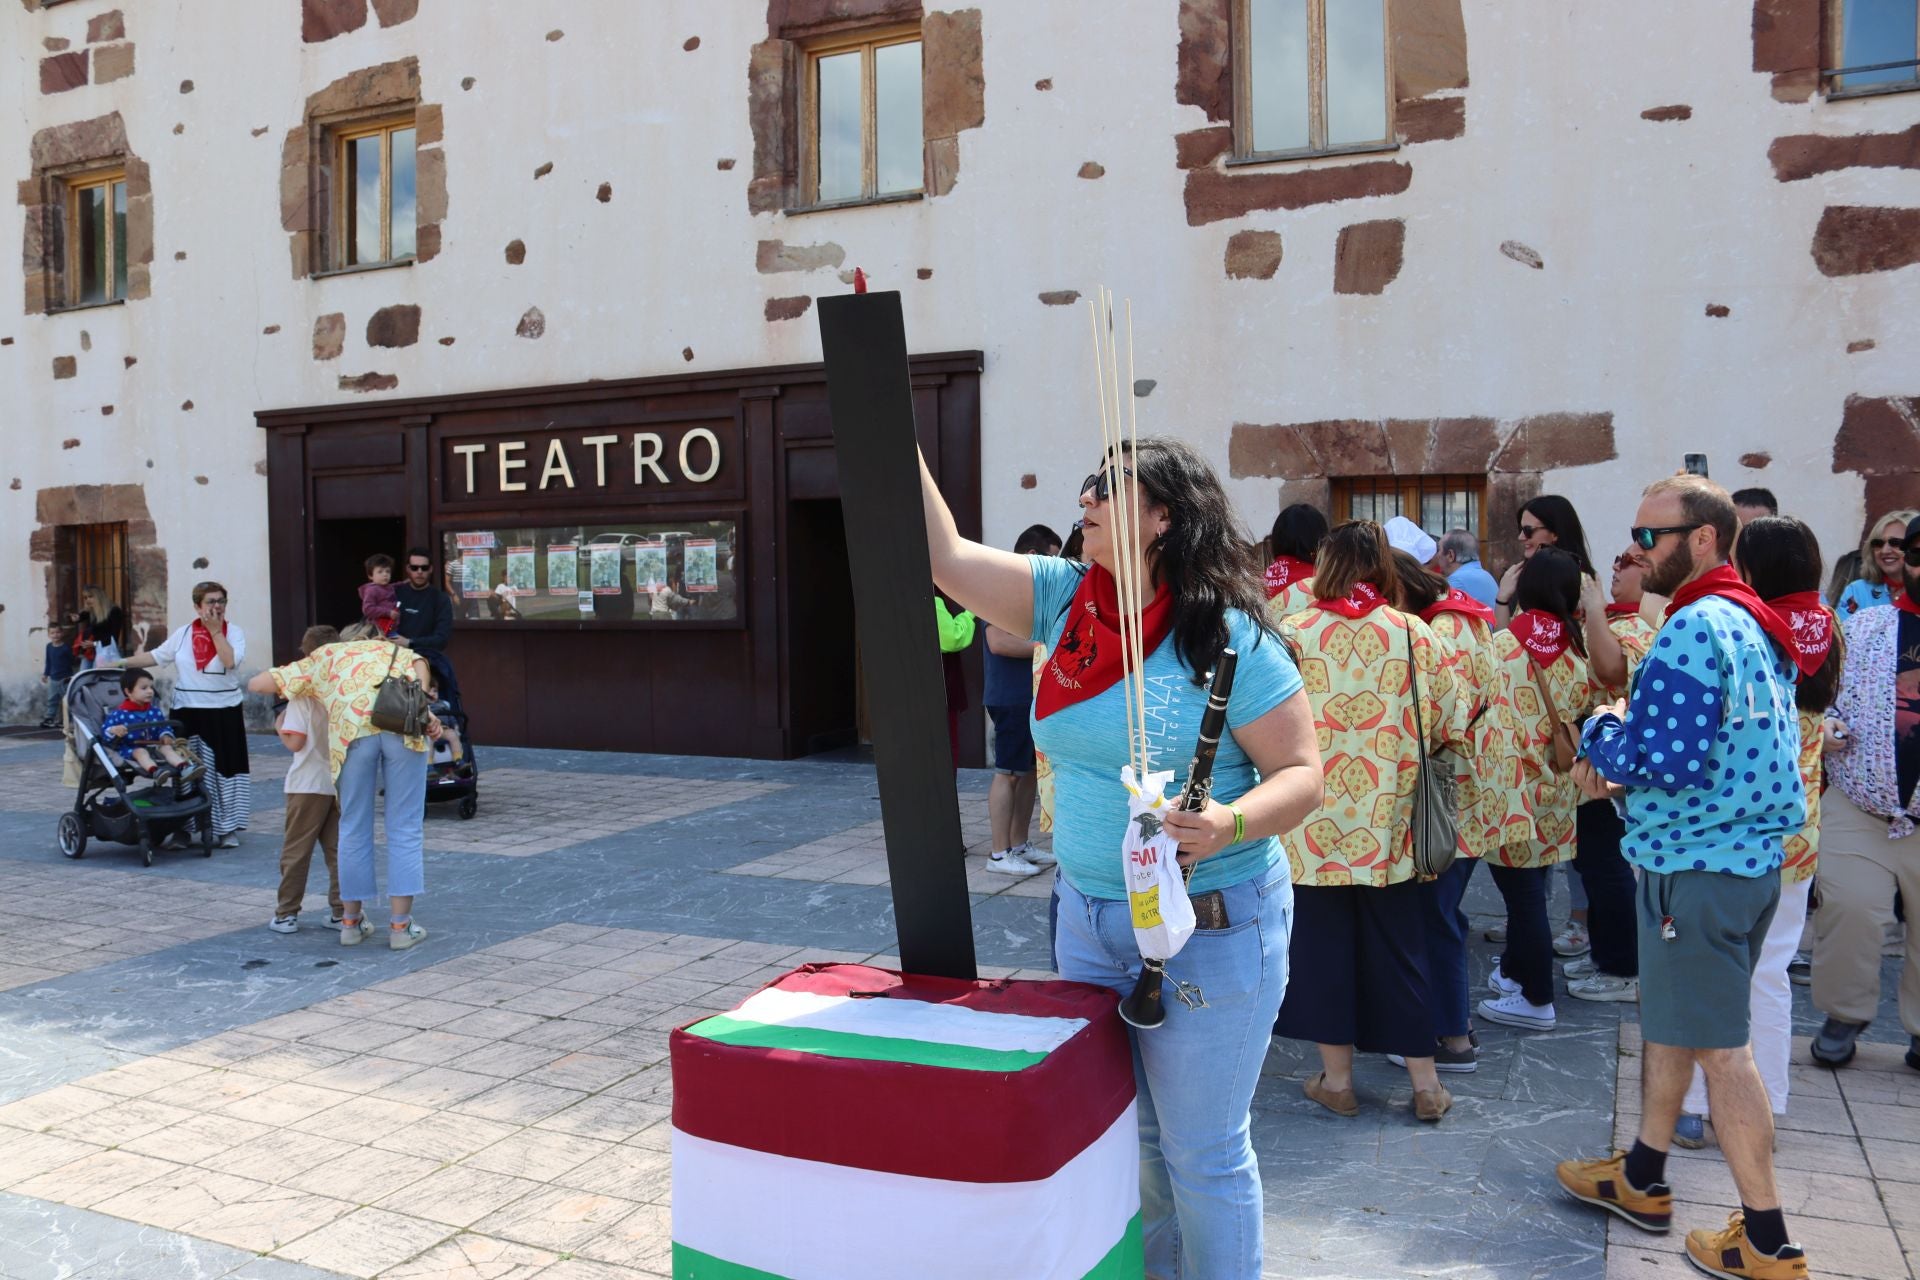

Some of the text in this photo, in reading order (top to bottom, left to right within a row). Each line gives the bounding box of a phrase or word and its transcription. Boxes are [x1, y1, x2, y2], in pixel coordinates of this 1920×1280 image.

[453, 427, 721, 493] TEATRO
[1525, 638, 1560, 653] EZCARAY
[1167, 674, 1185, 752] EZCARAY
